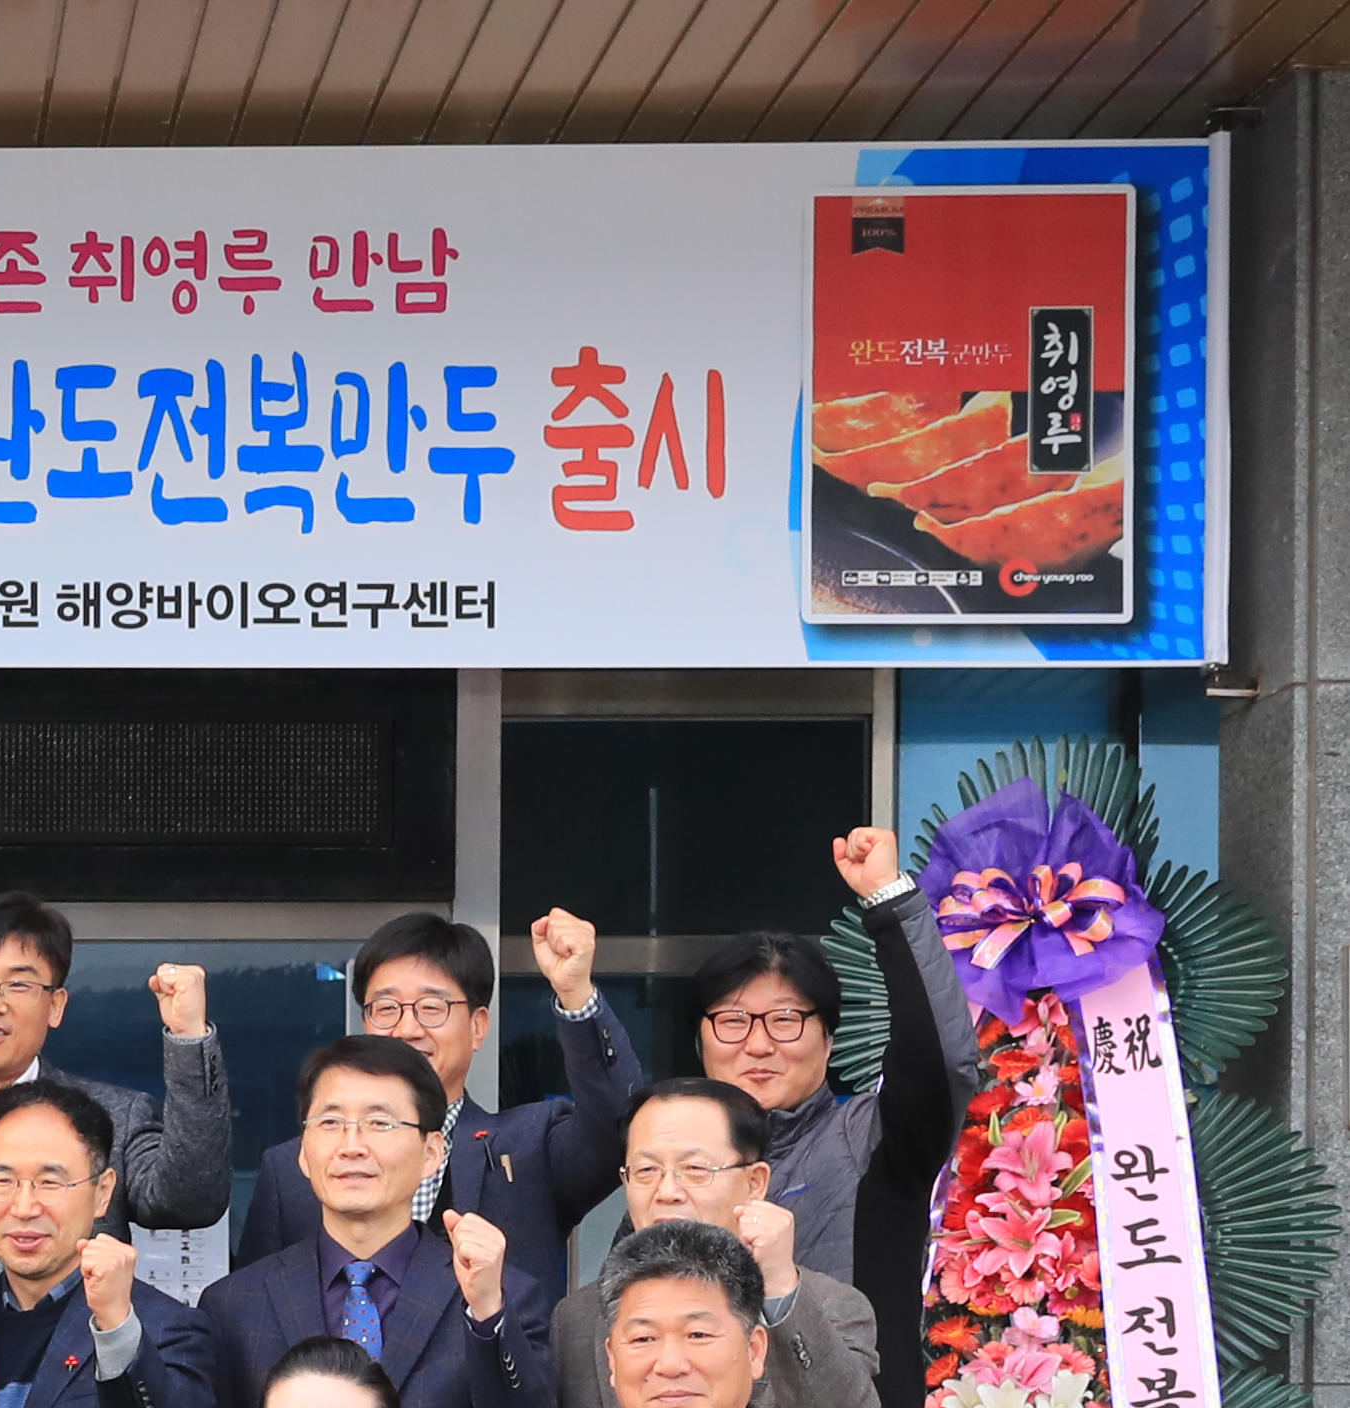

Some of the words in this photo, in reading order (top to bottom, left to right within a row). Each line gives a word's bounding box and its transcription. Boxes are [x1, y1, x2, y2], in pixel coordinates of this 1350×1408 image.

[69, 229, 281, 315] 취영루
[309, 228, 459, 314] 만남
[1040, 322, 1082, 454] 취영루
[544, 346, 725, 531] 출시
[57, 581, 494, 629] 해양바이오연구센터
[1042, 574, 1074, 585] young
[1076, 574, 1094, 582] roo
